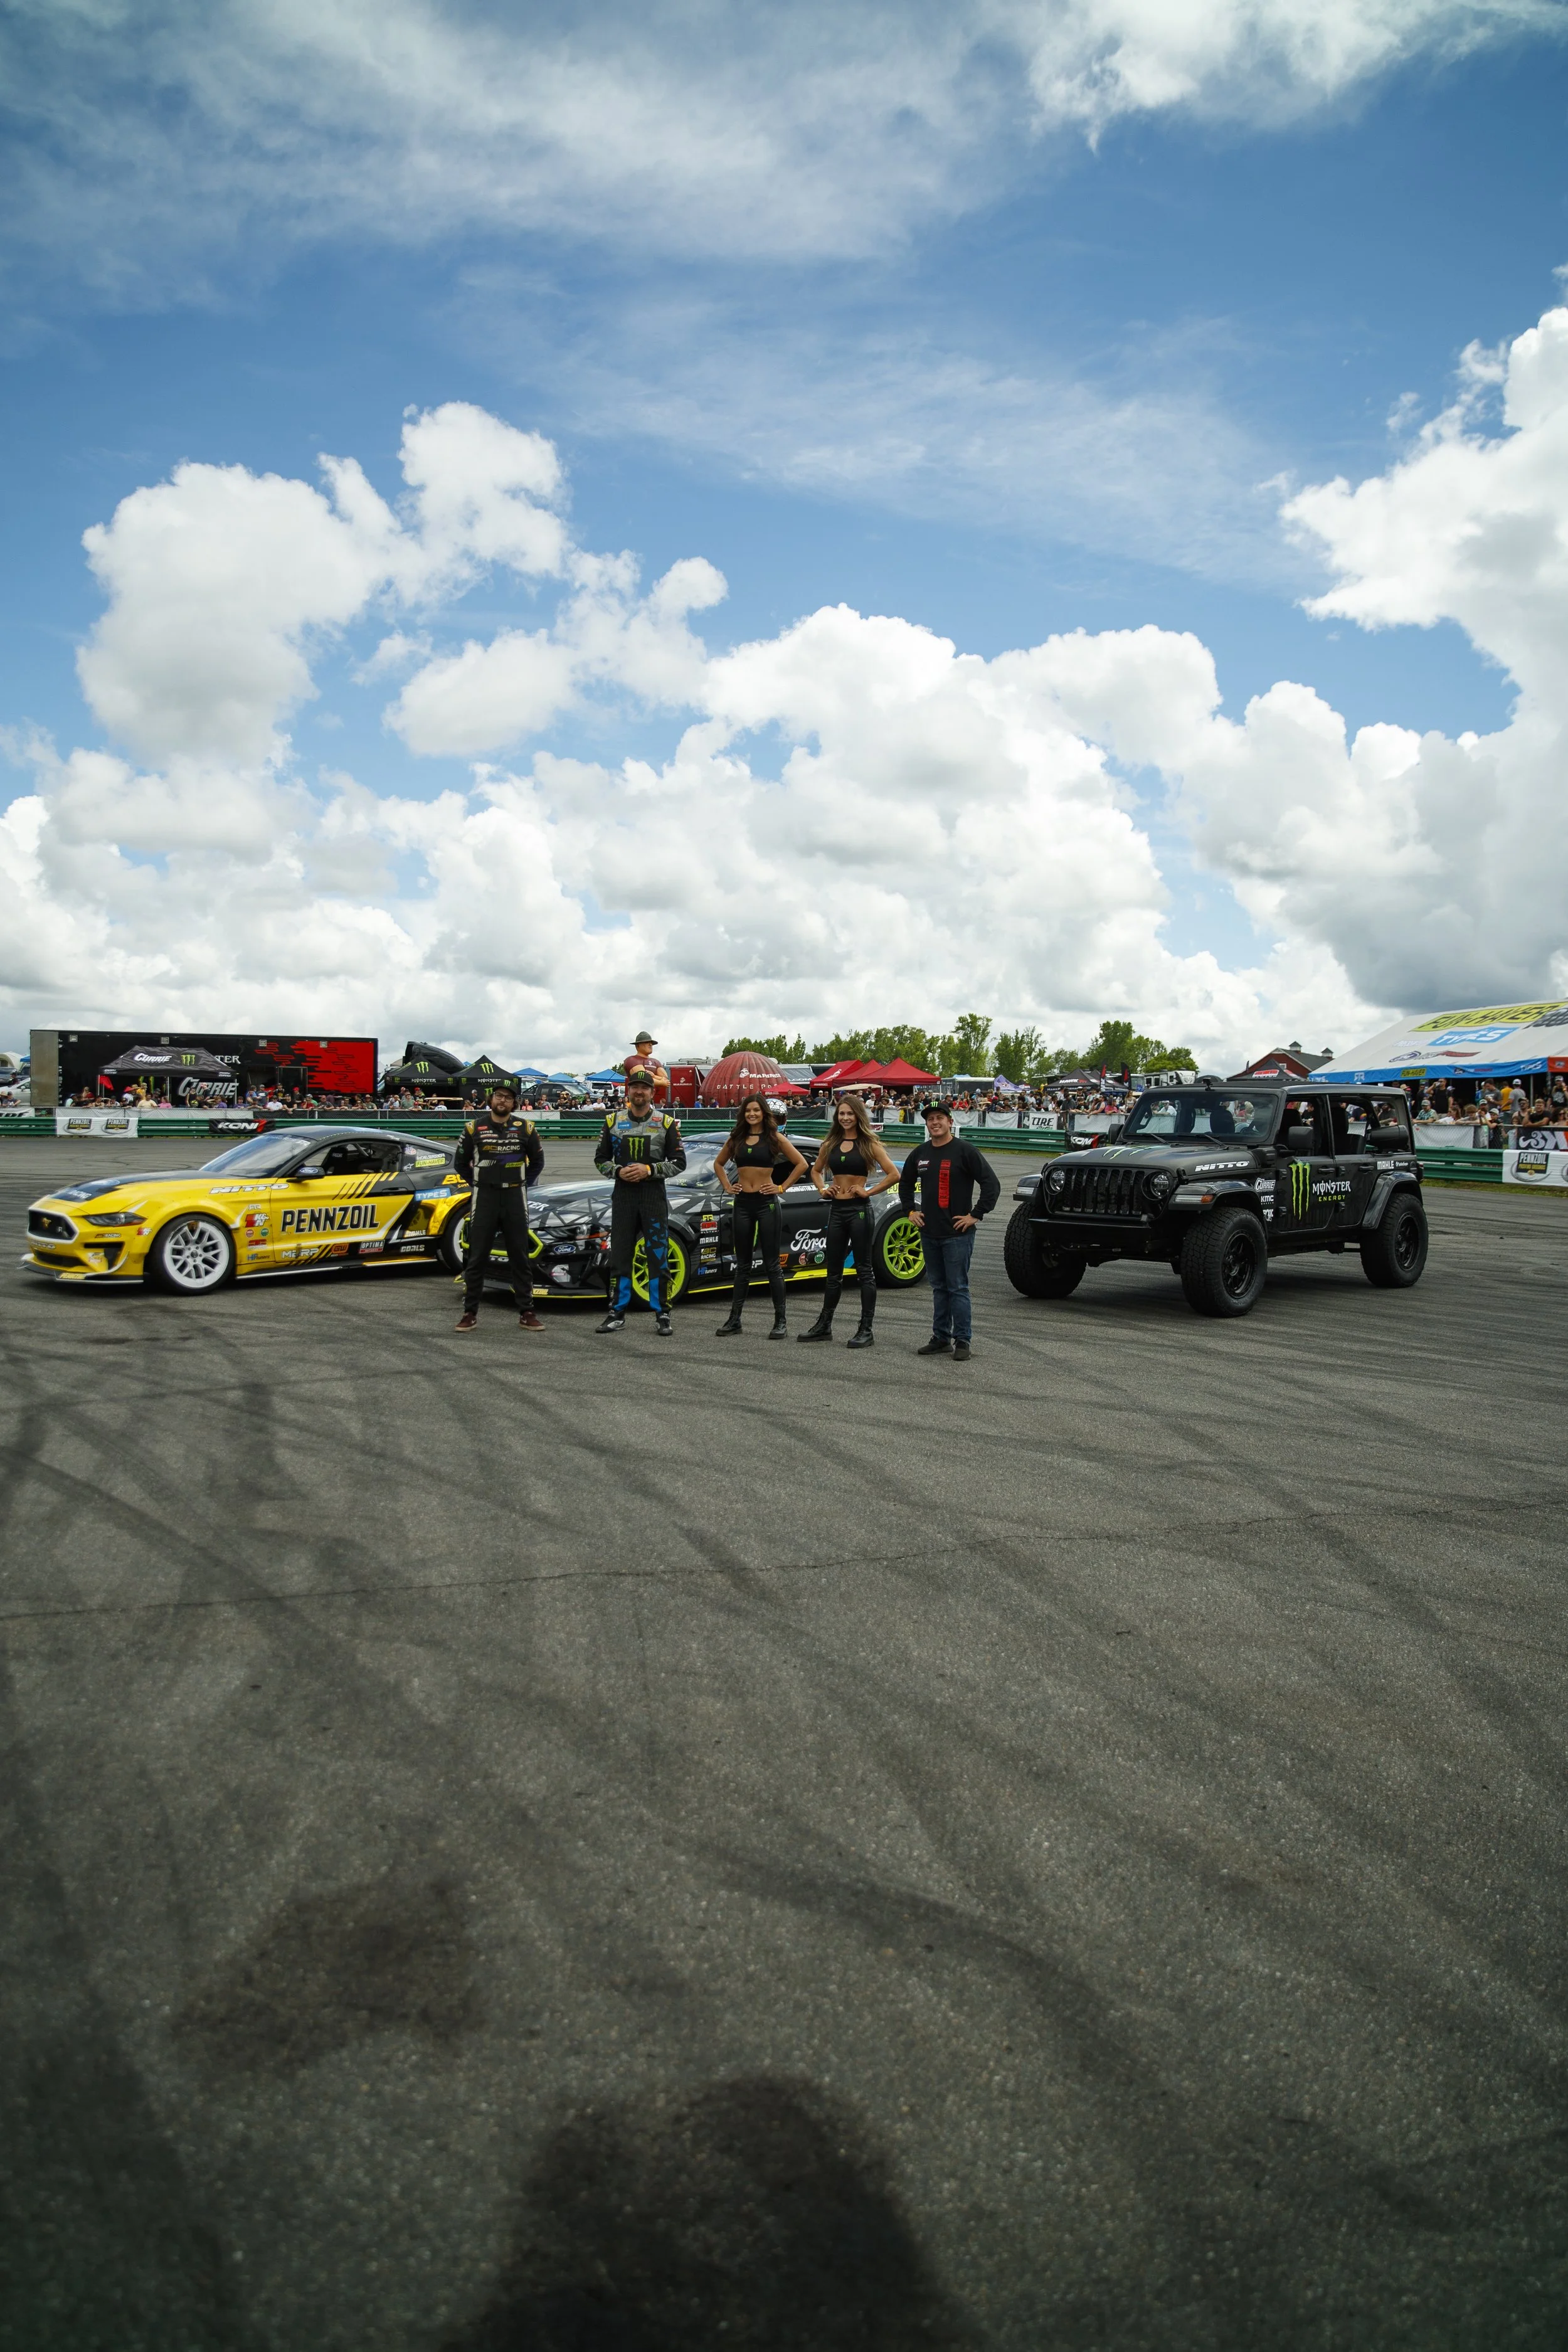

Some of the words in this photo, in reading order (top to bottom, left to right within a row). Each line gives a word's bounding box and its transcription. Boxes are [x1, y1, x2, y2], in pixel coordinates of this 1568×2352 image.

[1417, 1004, 1561, 1029] FUN-HAVER
[134, 1052, 172, 1062] CURRIE
[1032, 1117, 1054, 1126] TIRE
[416, 1158, 445, 1167] FUN-HAVER
[1519, 1153, 1547, 1164] PENNZOIL
[1195, 1160, 1250, 1172] NITTO
[1377, 1160, 1395, 1170] MAHLE
[209, 1183, 289, 1194] NITTO
[1255, 1177, 1276, 1190] CURRIE
[1312, 1180, 1352, 1195] MONSTER
[281, 1204, 381, 1235] PENNZOIL
[405, 1229, 427, 1237] MAHLE
[361, 1241, 384, 1249] OPTIMA
[699, 1236, 719, 1244] MAHLE
